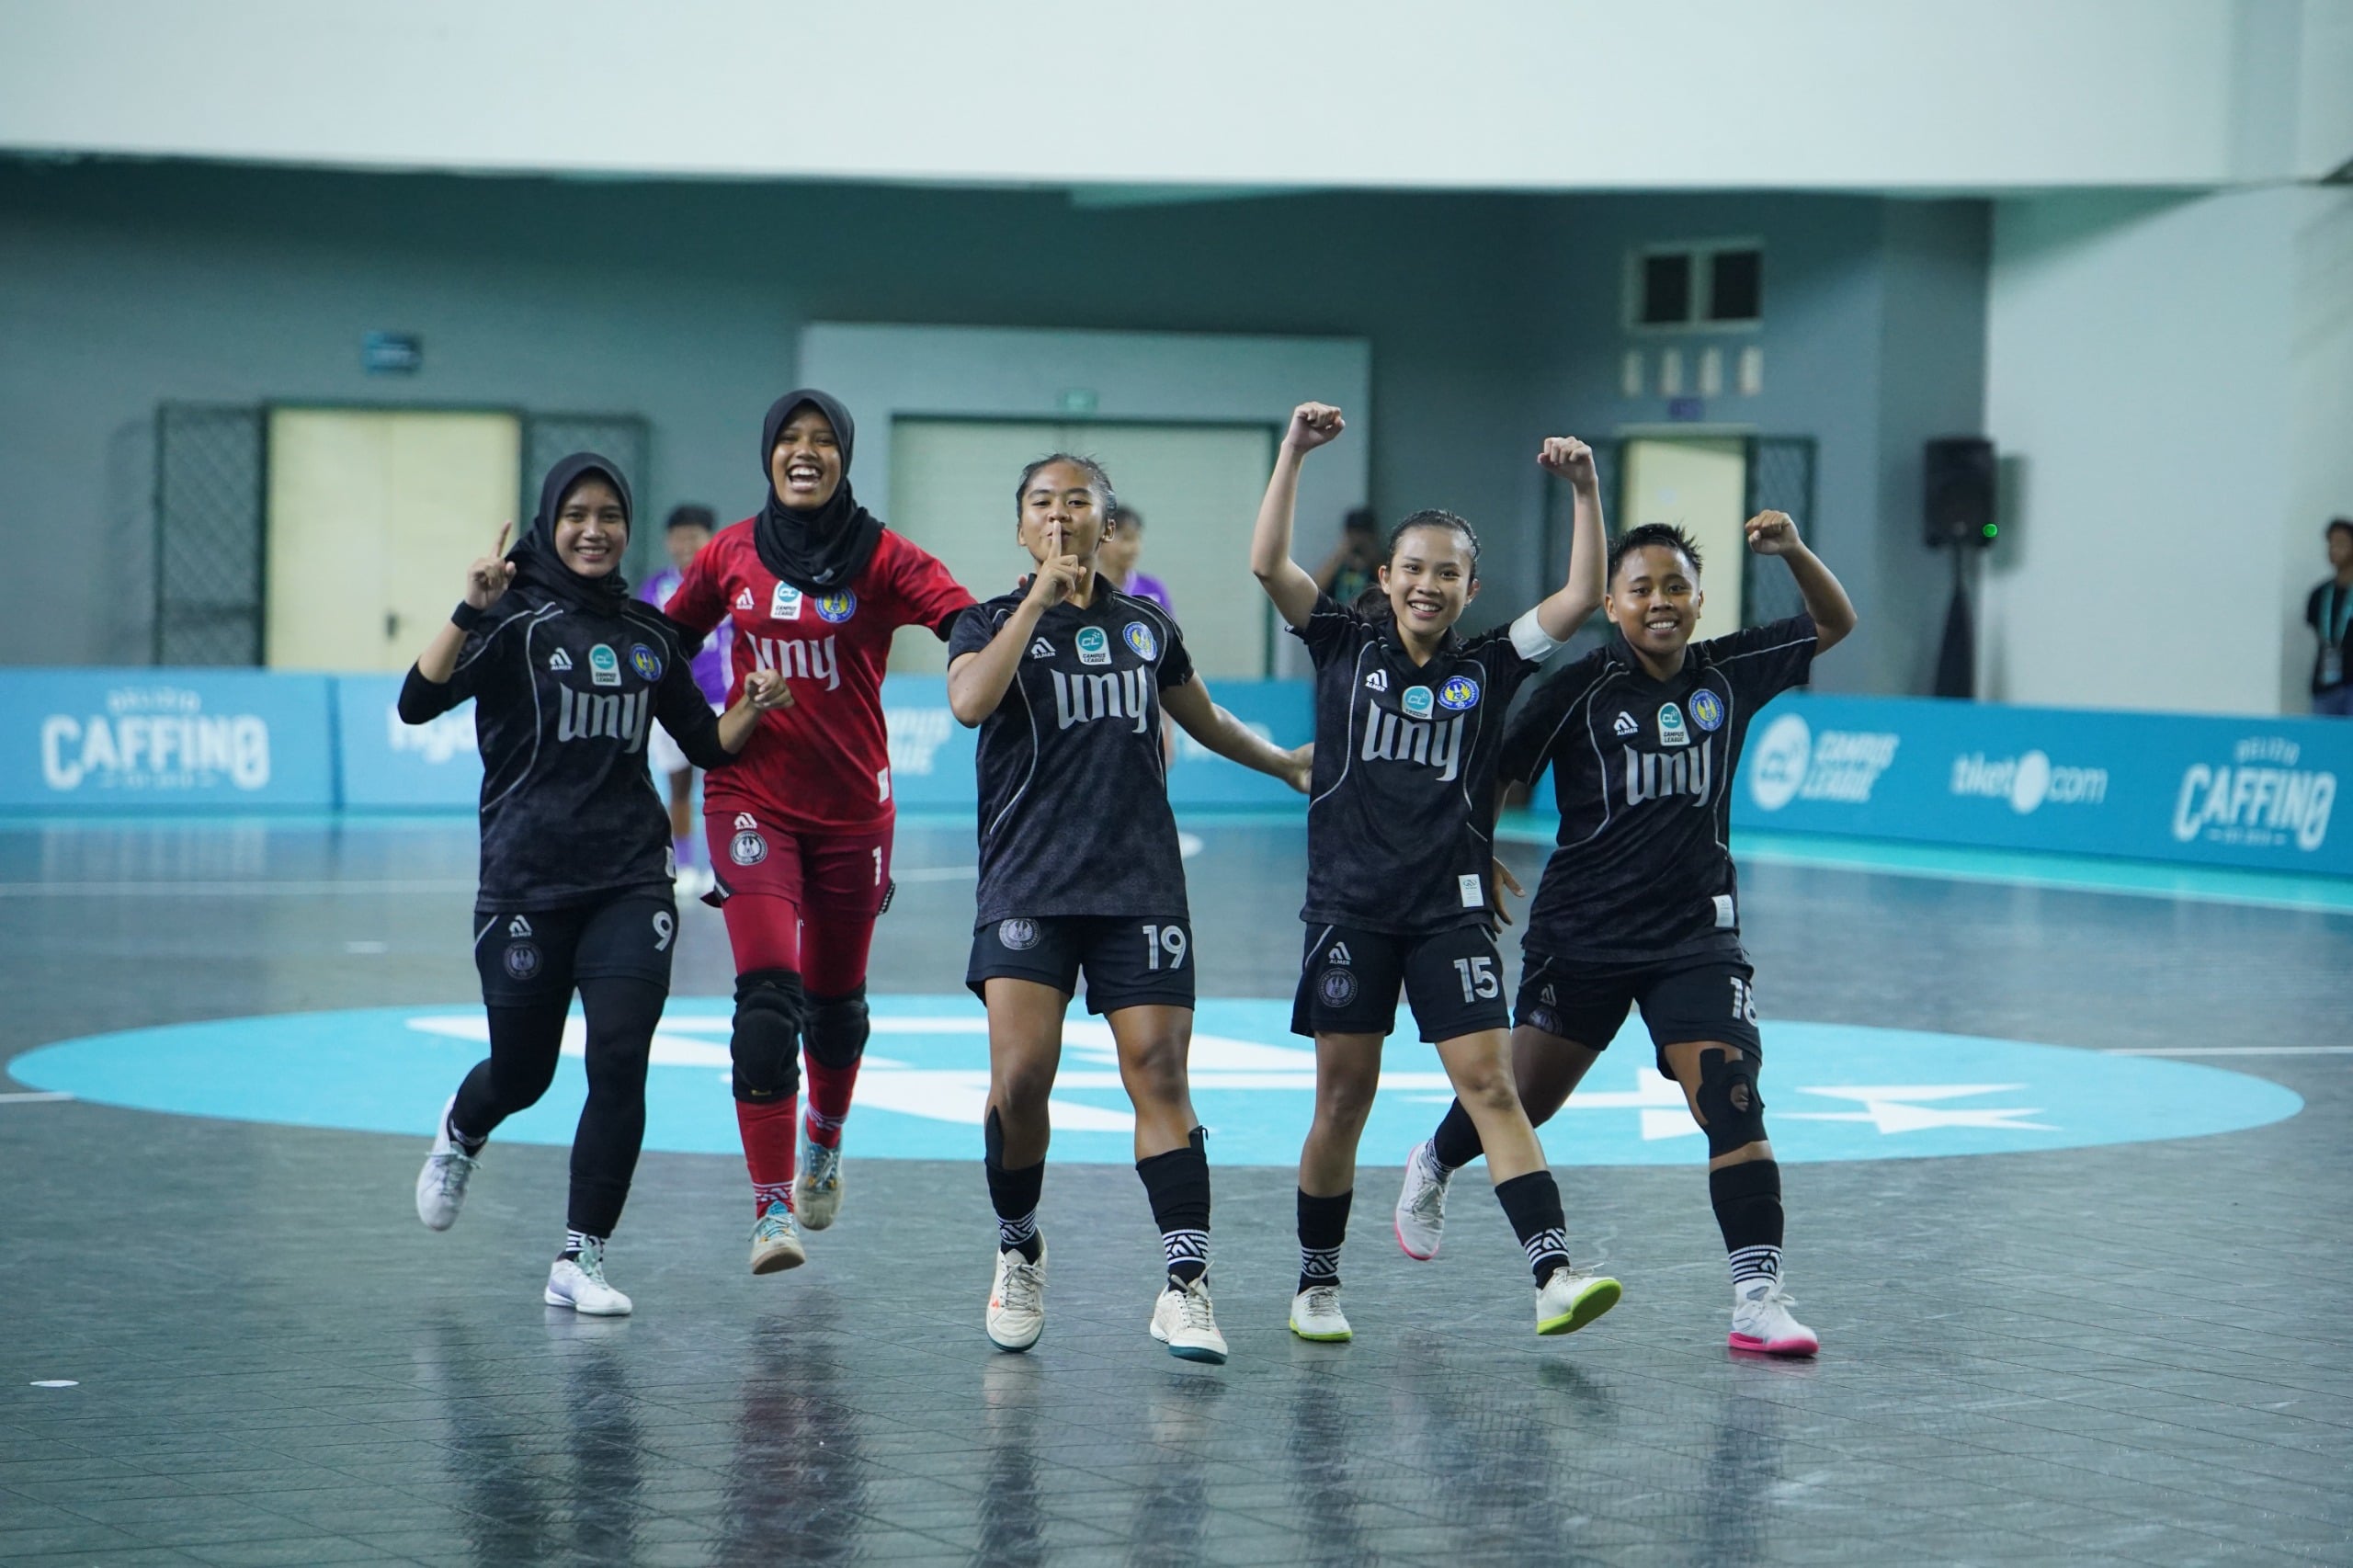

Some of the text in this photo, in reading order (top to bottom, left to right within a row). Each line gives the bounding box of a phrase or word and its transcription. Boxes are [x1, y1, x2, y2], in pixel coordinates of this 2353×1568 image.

[1081, 636, 1100, 647] CL
[1407, 695, 1426, 705] CL
[40, 714, 270, 791] CAFFINO
[2172, 763, 2336, 851] CAFFINO
[872, 846, 882, 887] 1
[653, 910, 674, 951] 9
[1142, 925, 1187, 970] 19
[1453, 956, 1499, 1004] 15
